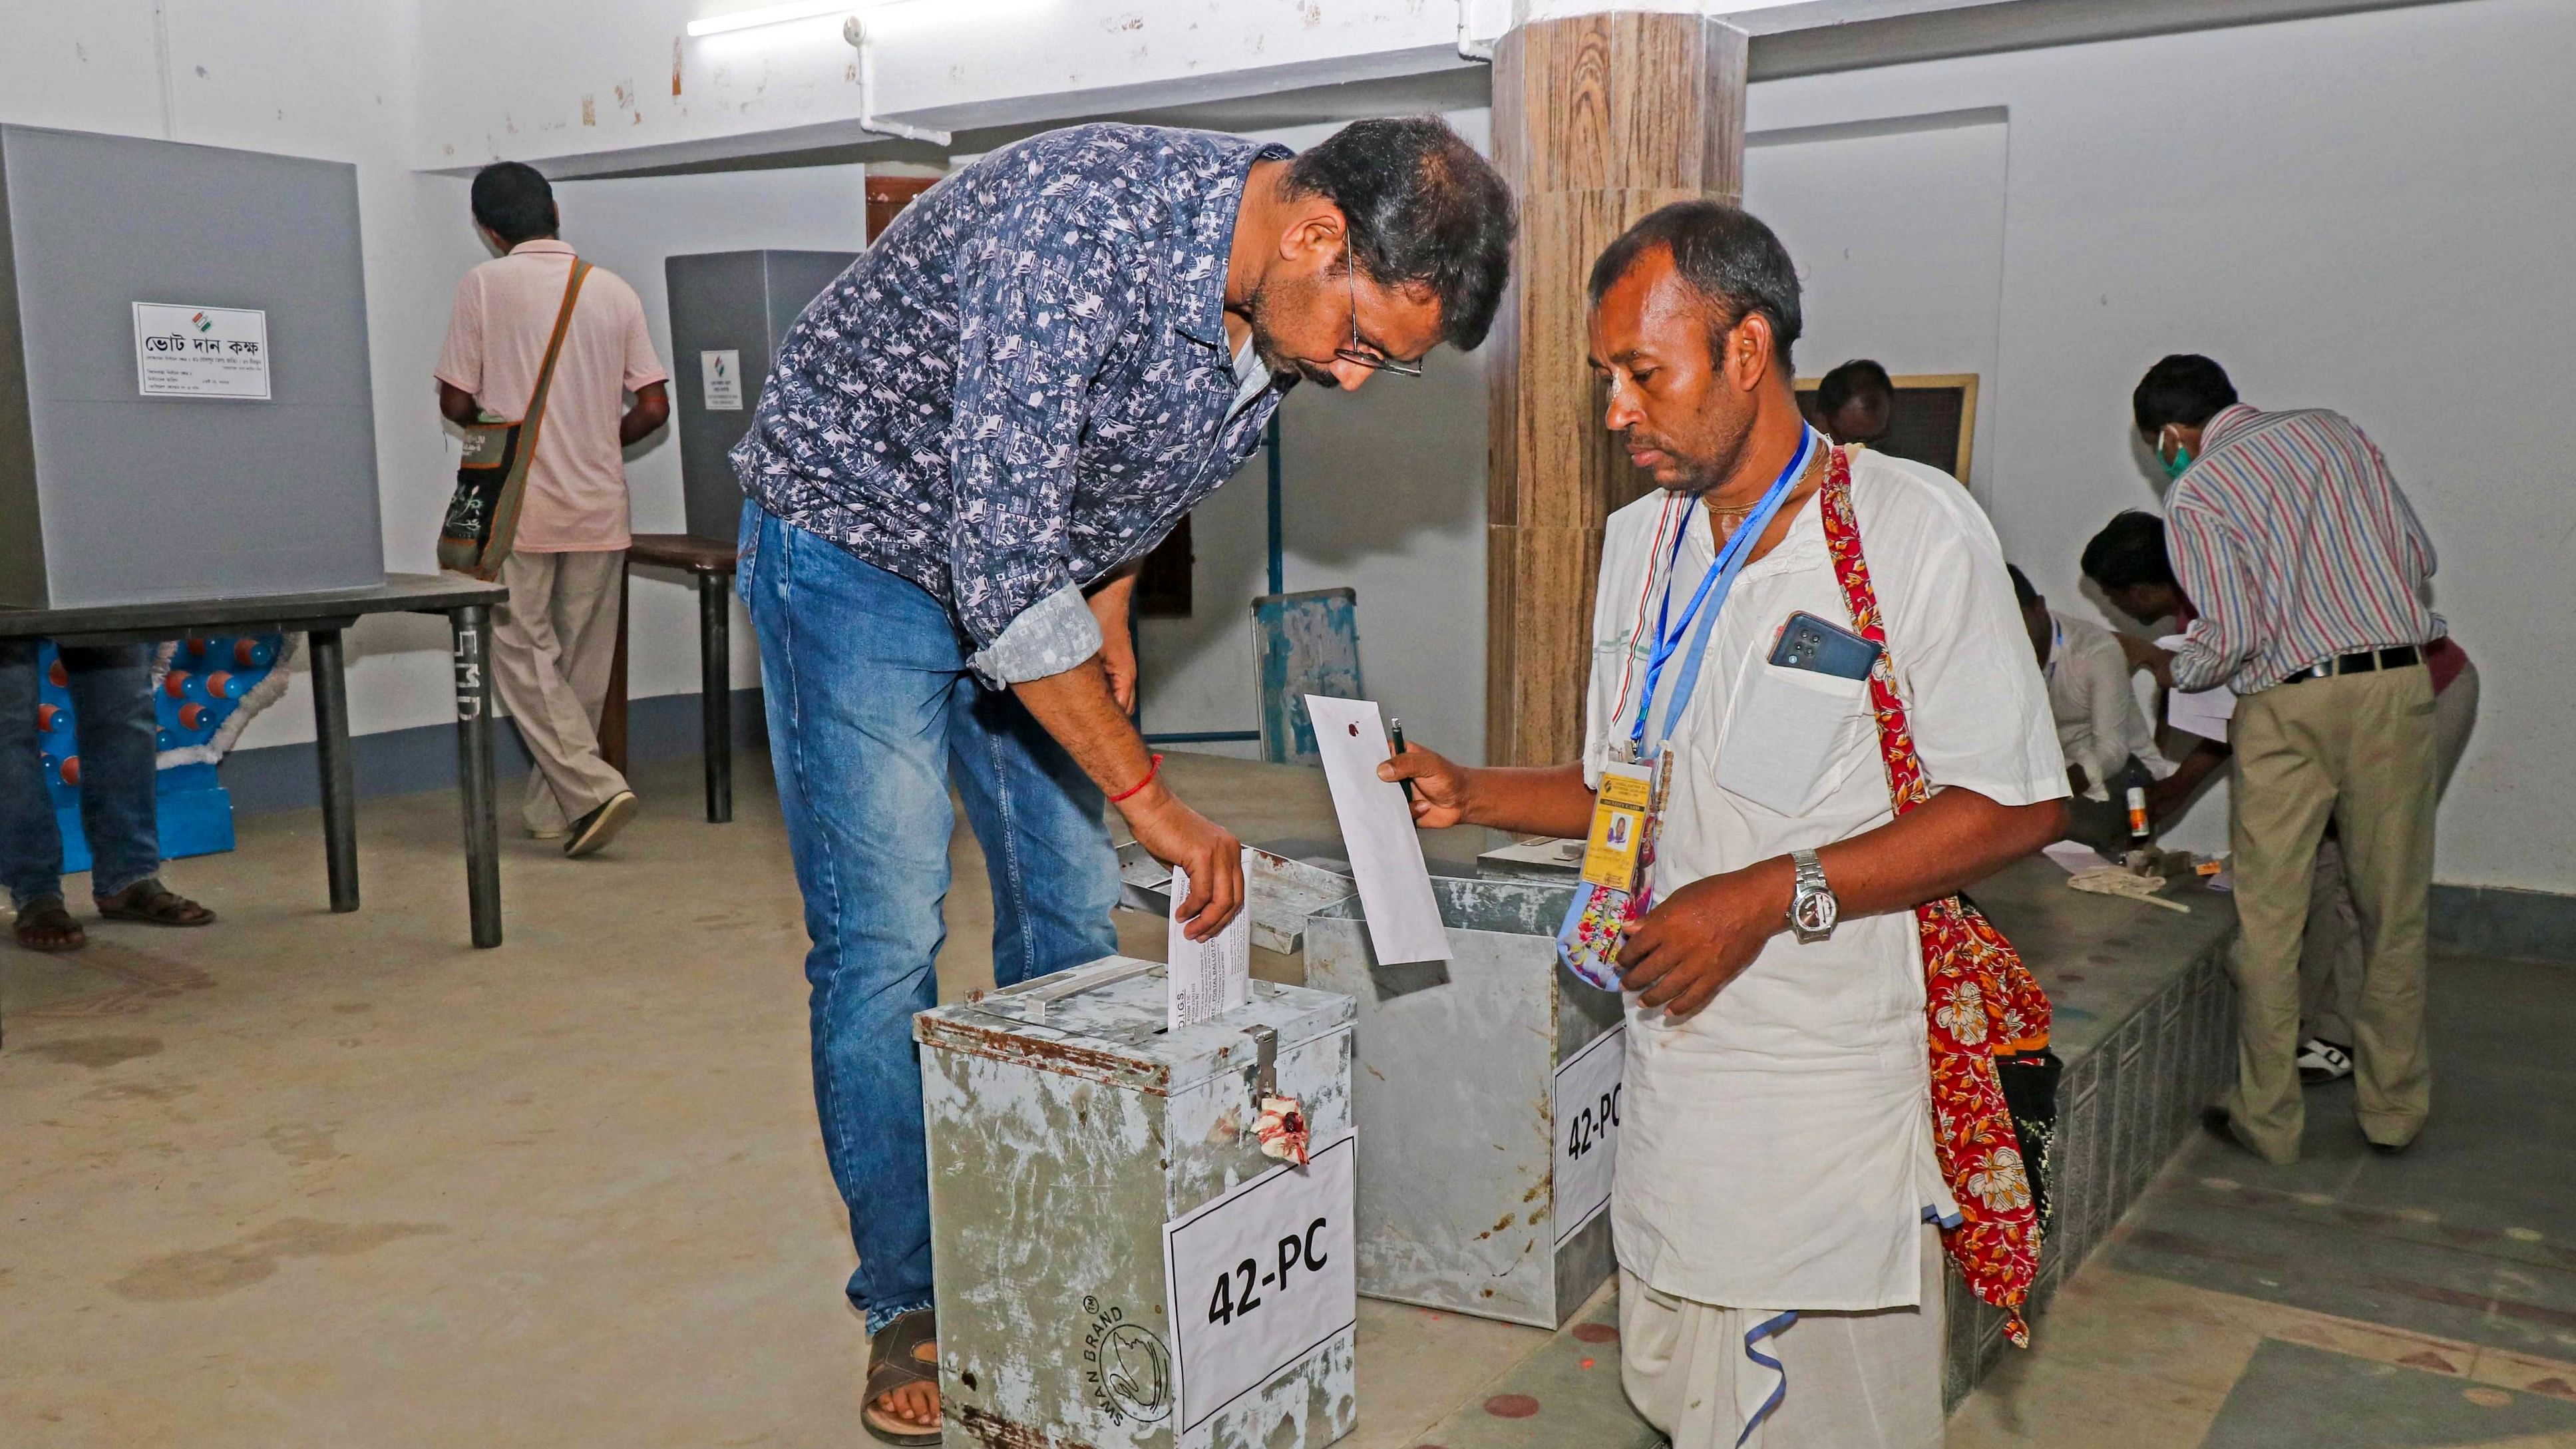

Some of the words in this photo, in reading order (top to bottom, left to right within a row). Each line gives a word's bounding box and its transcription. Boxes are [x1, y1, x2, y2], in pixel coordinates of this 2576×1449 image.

[146, 333, 186, 351] ভোট
[192, 337, 220, 354] দান
[228, 340, 260, 355] কক্ষ
[1568, 1082, 1622, 1161] 42-PC
[1208, 1217, 1328, 1326] 42-PC
[1083, 1307, 1123, 1362] BRAND
[1086, 1371, 1123, 1427] SWAN
